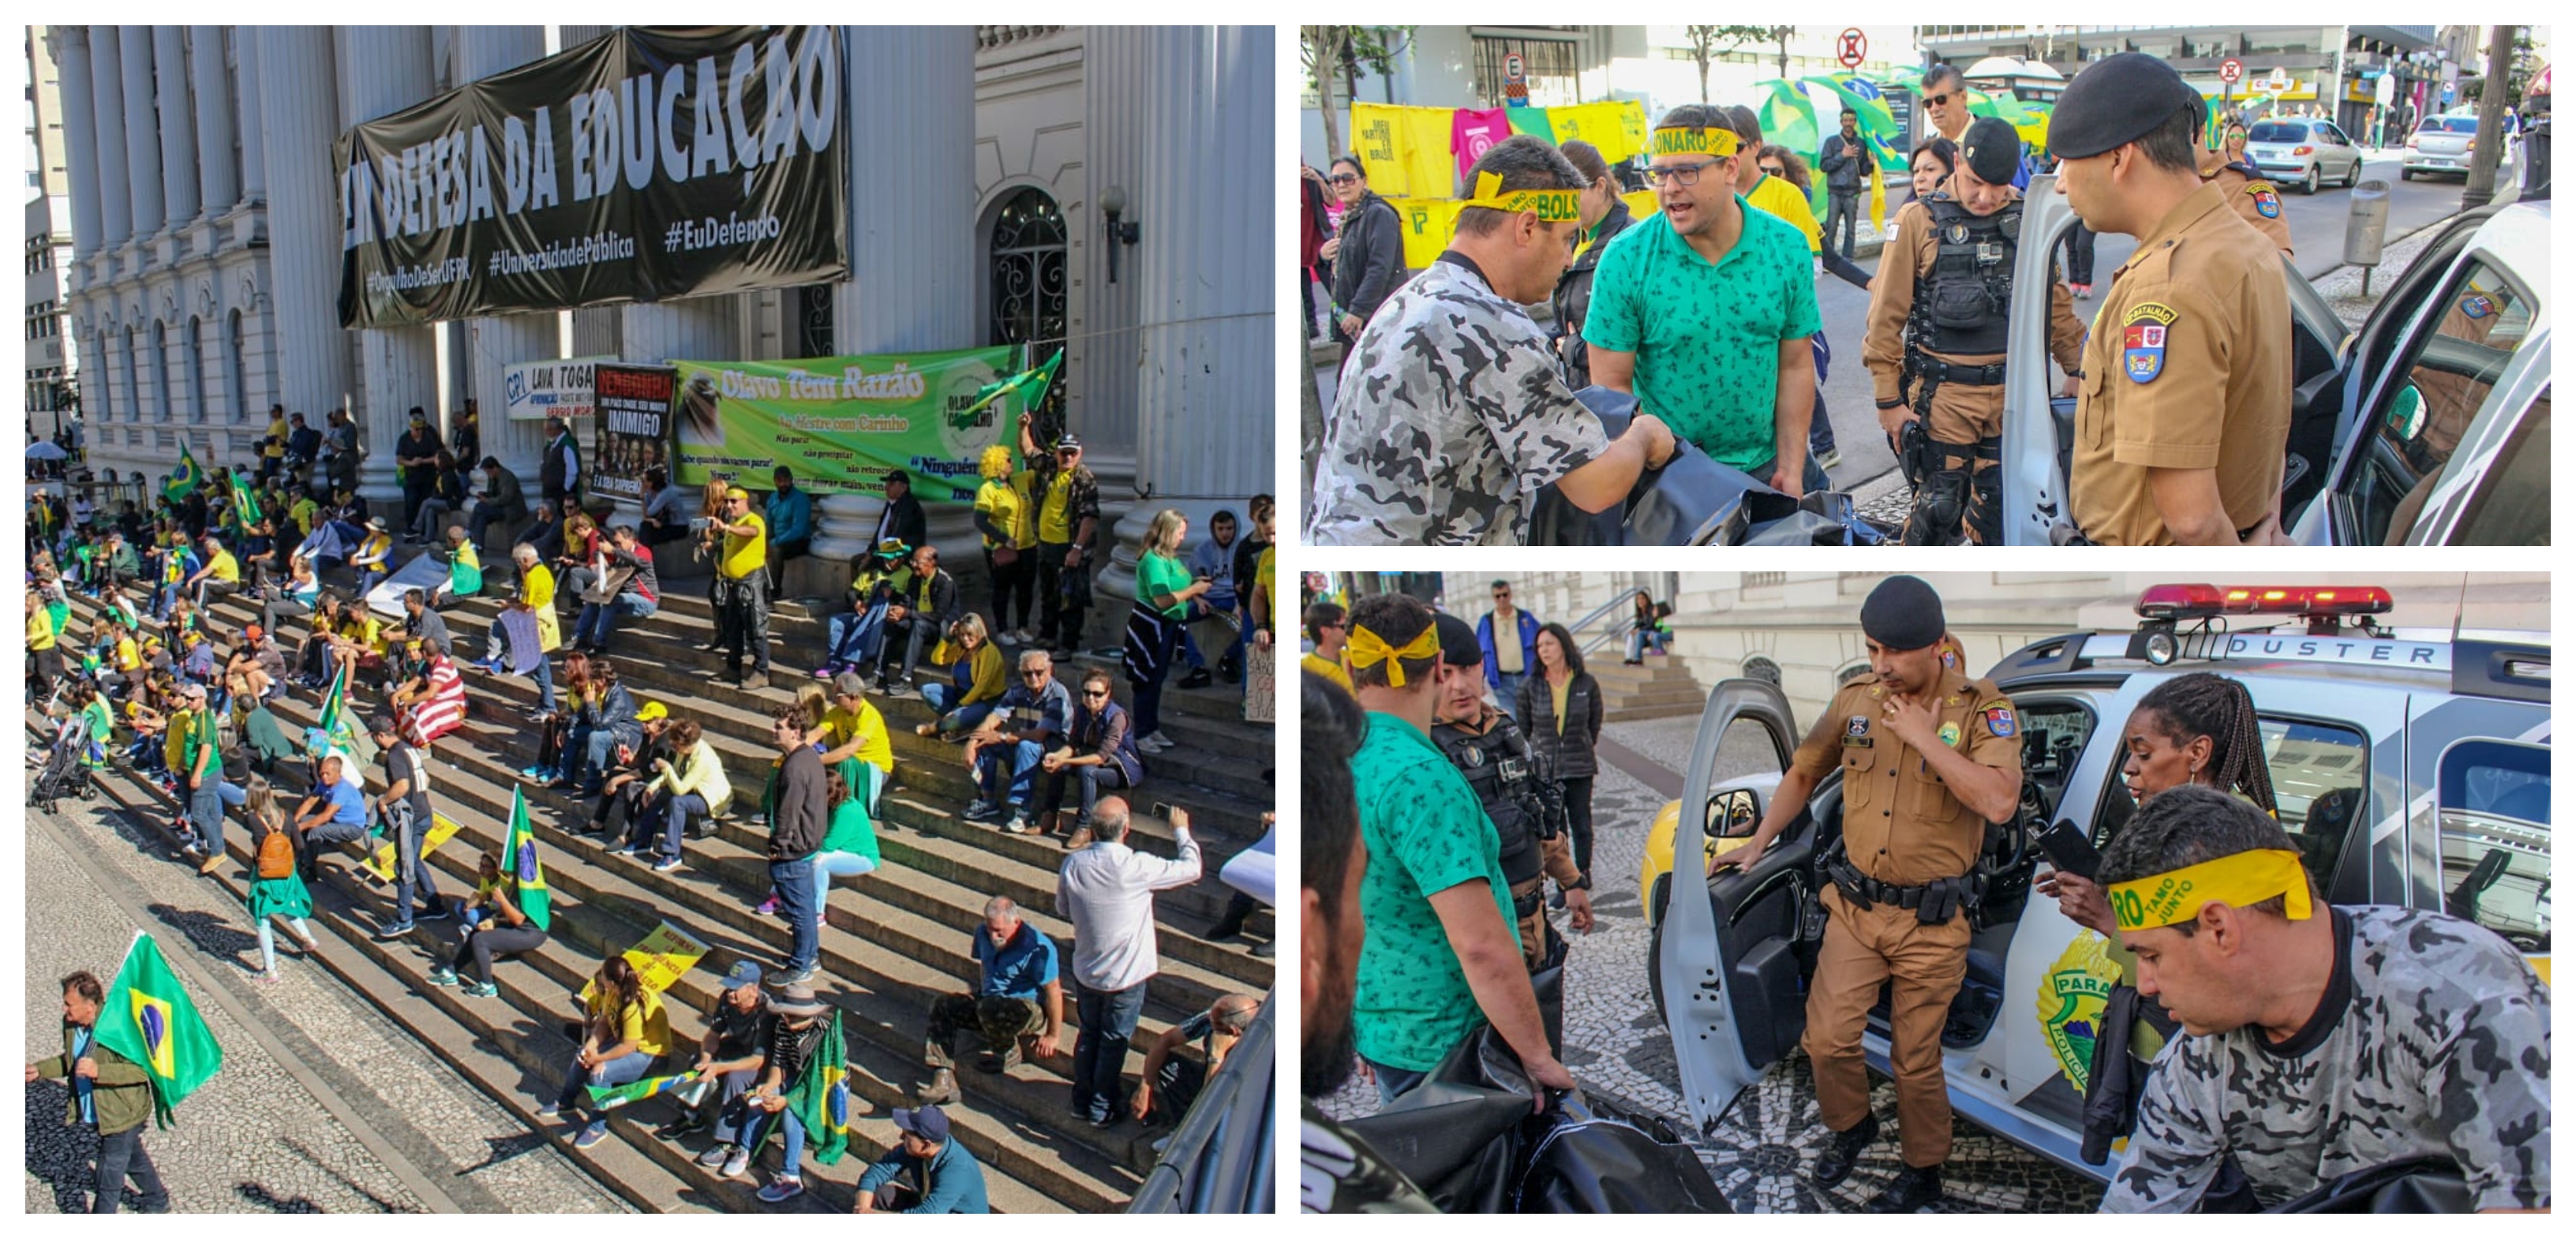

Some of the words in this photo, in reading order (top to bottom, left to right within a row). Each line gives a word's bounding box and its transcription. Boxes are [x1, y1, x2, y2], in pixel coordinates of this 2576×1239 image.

[1508, 58, 1519, 77] E
[382, 124, 494, 240] DEFESA
[504, 105, 559, 215] DA
[570, 25, 837, 197] EDUCAÇÃO
[1653, 131, 1708, 155] ONARO
[1410, 211, 1428, 234] 17
[489, 230, 635, 277] #UniversidadePública
[665, 207, 780, 253] #EuDefendo
[506, 369, 526, 400] CPI
[532, 367, 554, 390] LAVA
[560, 365, 593, 389] TOGA
[786, 369, 837, 401] Tem
[842, 361, 925, 400] Razão
[546, 406, 571, 417] SERGIO
[608, 409, 661, 438] INIMIGO
[794, 414, 832, 431] Mestre
[833, 419, 857, 432] com
[858, 414, 908, 432] Carinho
[776, 434, 790, 444] Não
[2229, 638, 2436, 664] DUSTER
[2113, 888, 2145, 927] RO
[2144, 877, 2175, 914] TAMO
[2159, 879, 2193, 925] JUNTO
